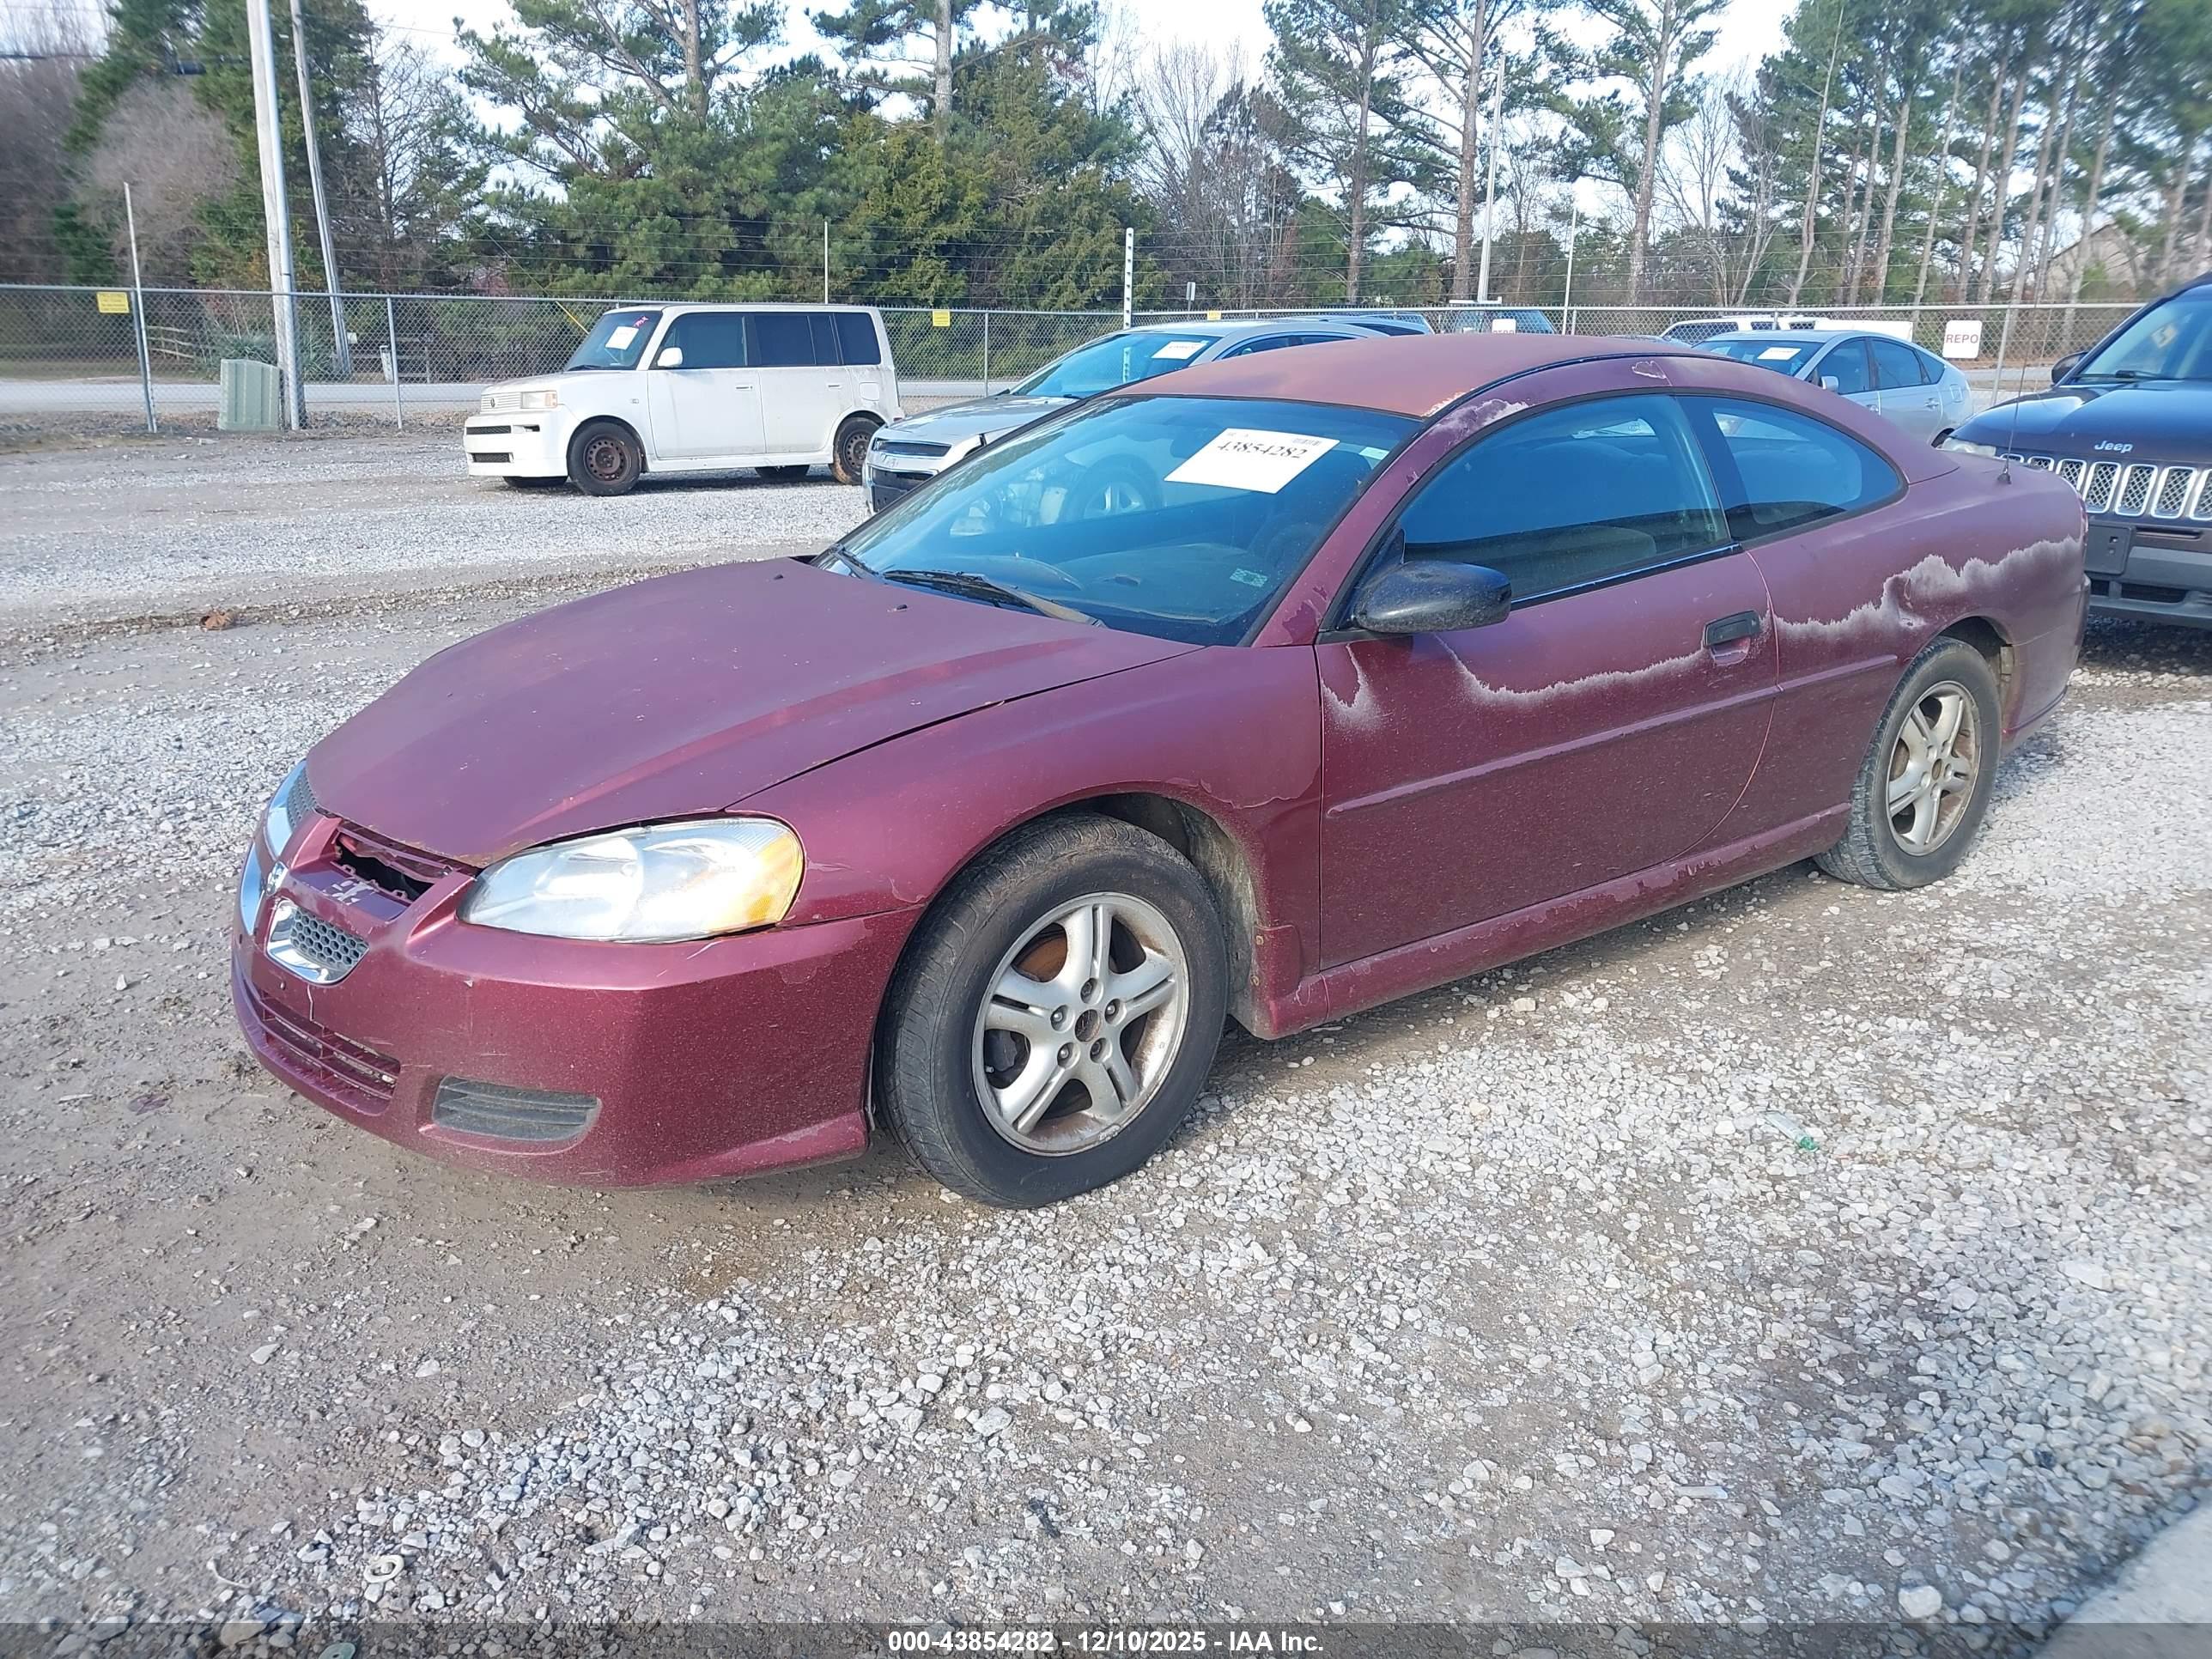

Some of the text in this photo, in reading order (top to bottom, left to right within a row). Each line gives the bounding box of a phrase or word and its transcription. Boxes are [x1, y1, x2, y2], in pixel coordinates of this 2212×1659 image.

[1946, 334, 1978, 343] REPO
[1218, 441, 1307, 459] 43854282
[2094, 440, 2133, 453] Jeep
